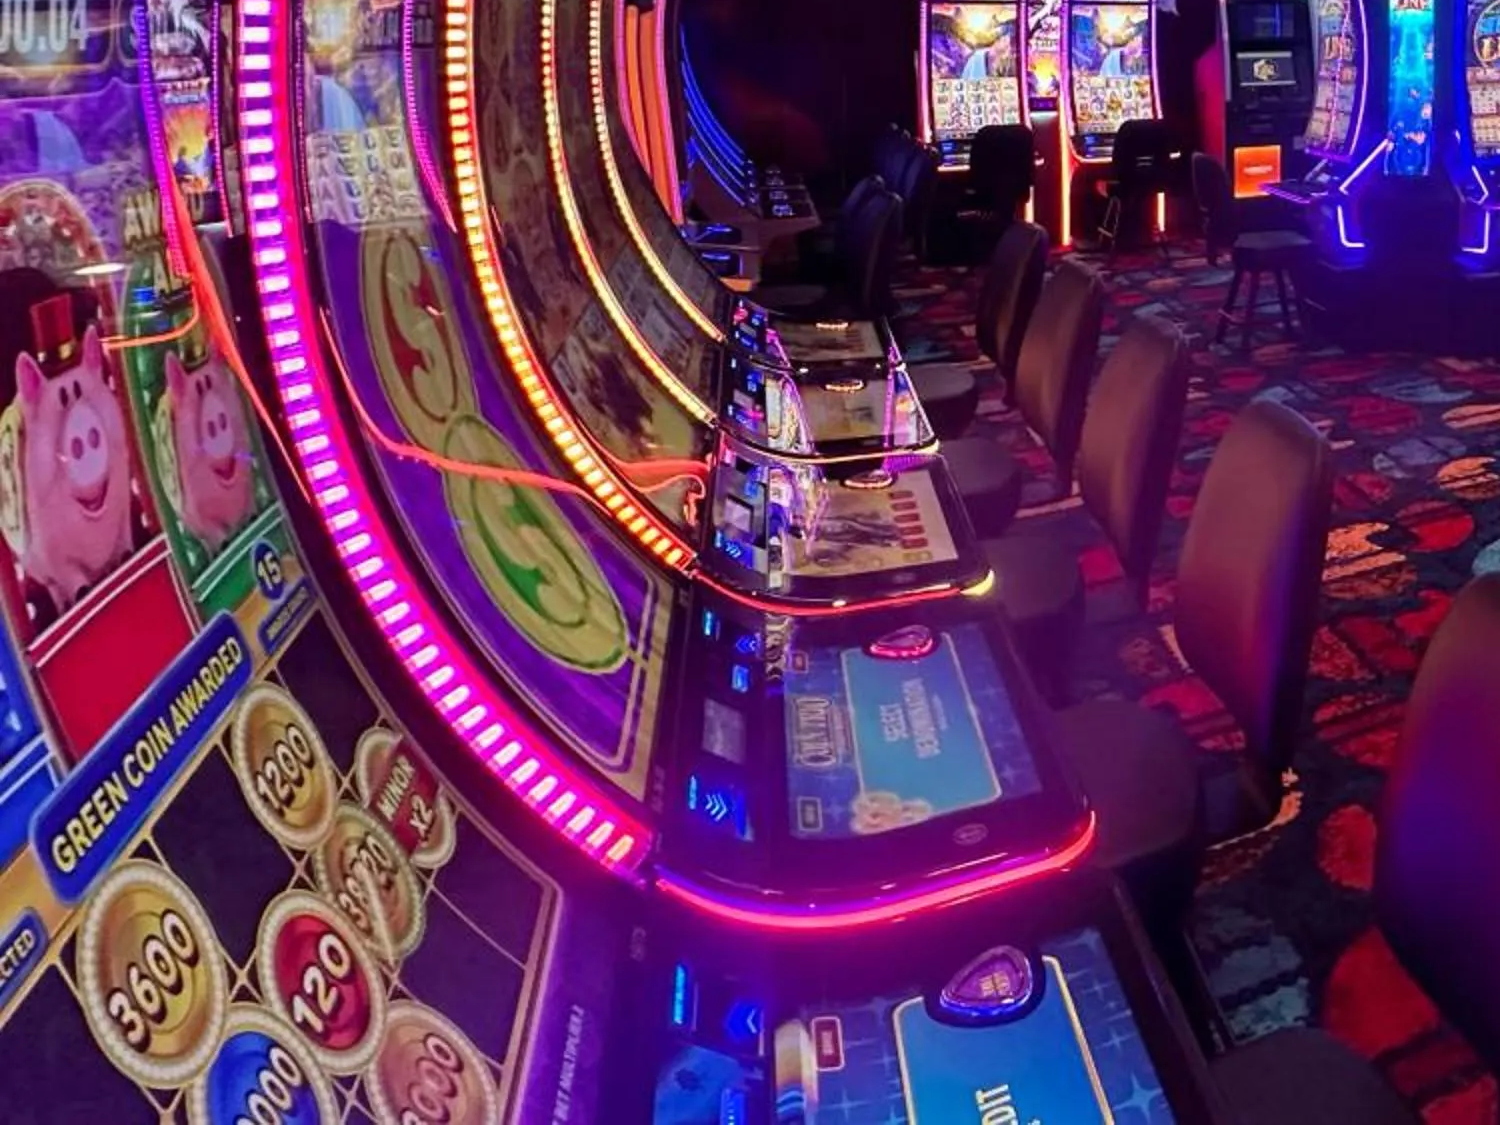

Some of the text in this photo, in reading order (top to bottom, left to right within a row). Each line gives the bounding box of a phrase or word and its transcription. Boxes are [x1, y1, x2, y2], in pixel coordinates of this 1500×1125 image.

[258, 547, 282, 592] 15
[50, 637, 244, 875] GREEN COIN AWARDED
[256, 723, 313, 813] 1200
[376, 755, 415, 822] MINOR
[107, 908, 196, 1049] 3600
[290, 933, 353, 1035] 120
